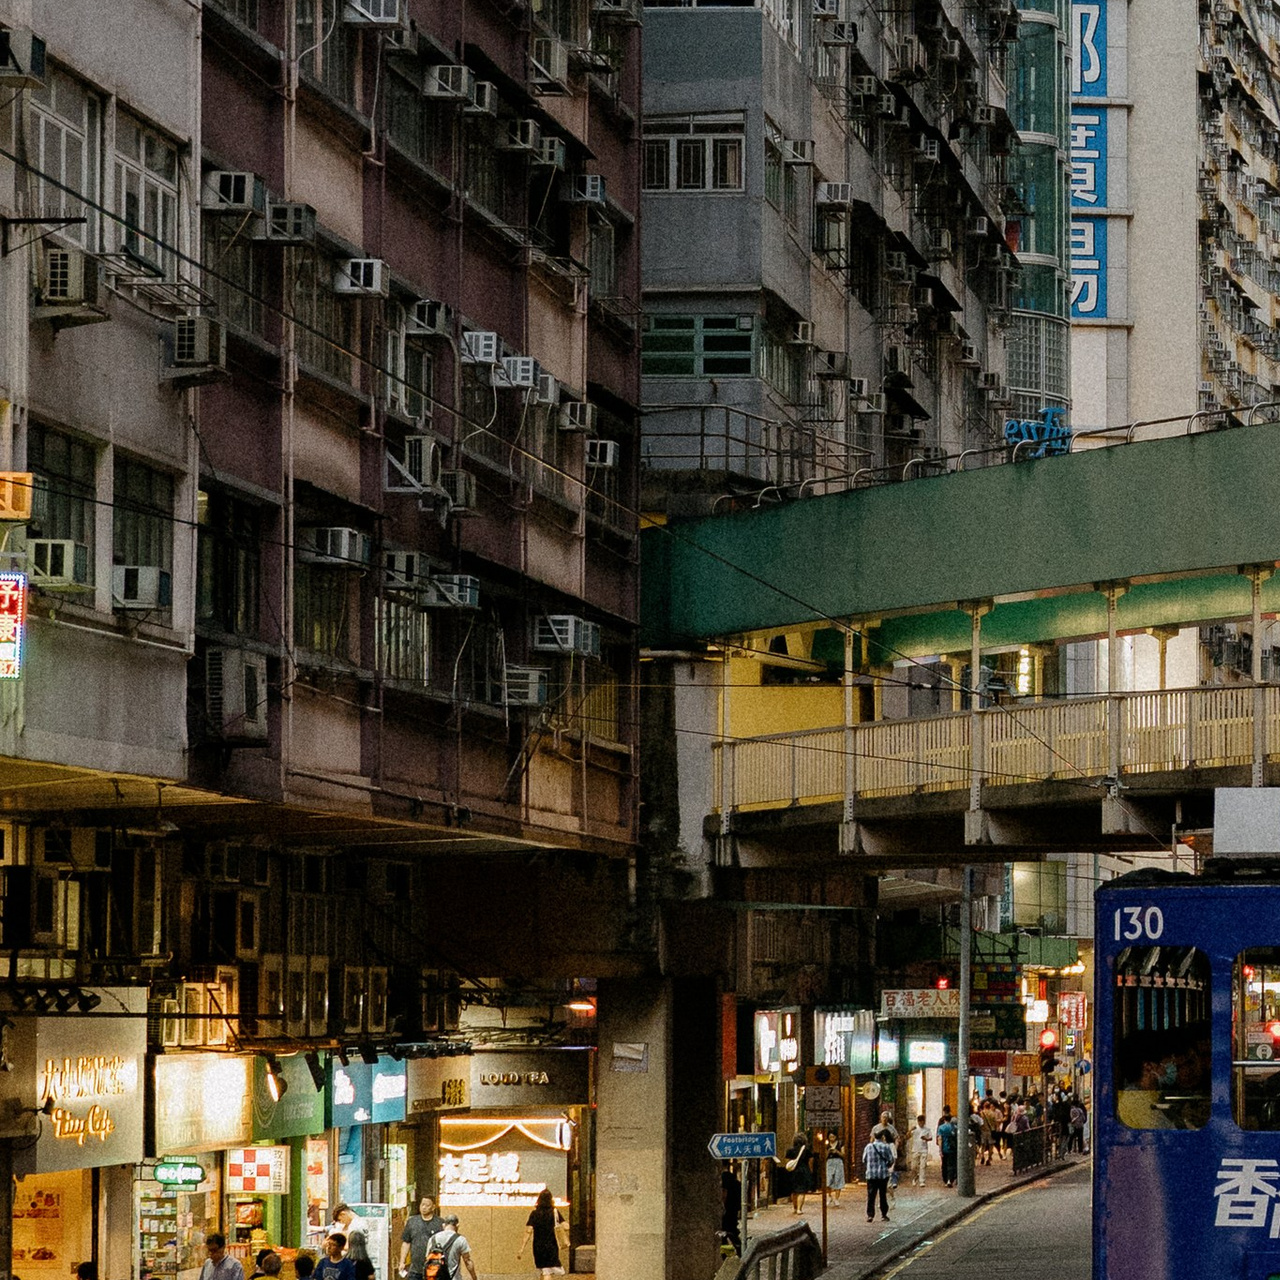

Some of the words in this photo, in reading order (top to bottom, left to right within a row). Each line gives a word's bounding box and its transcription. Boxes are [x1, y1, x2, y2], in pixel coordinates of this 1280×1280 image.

[1114, 906, 1164, 941] 130
[722, 1136, 759, 1145] Footbridge
[724, 1144, 762, 1154] 行人天橋
